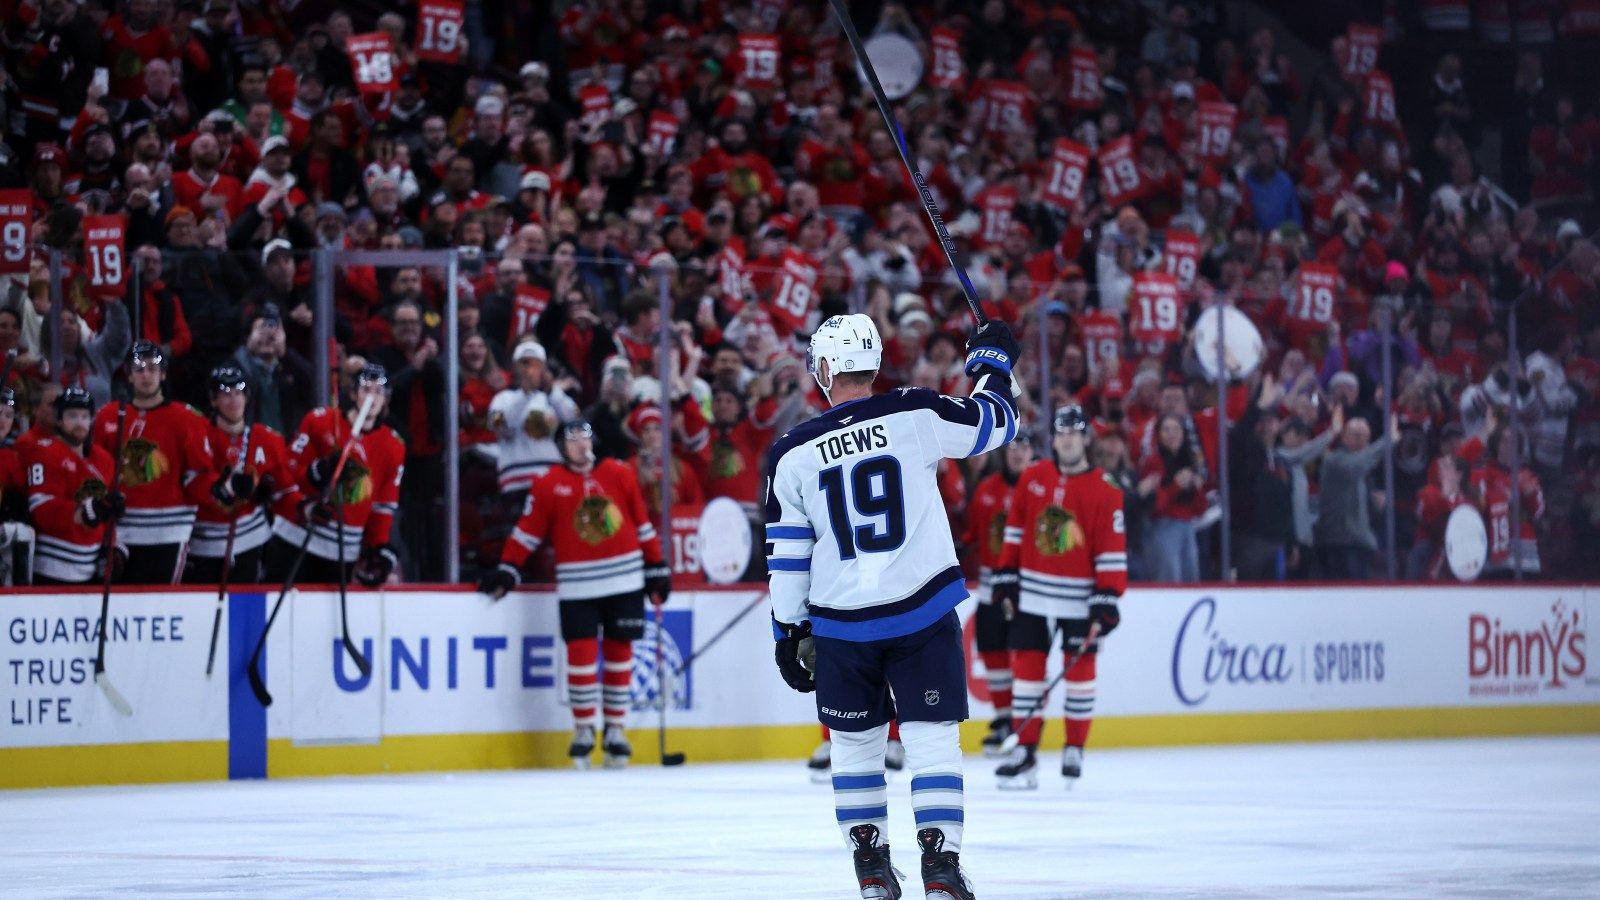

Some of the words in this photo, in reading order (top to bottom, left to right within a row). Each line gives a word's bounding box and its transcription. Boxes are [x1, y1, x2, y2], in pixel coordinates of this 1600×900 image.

[422, 16, 460, 53] 19
[743, 48, 778, 80] 19
[1347, 44, 1377, 73] 19
[1200, 124, 1231, 156] 19
[1048, 162, 1084, 200] 19
[1104, 157, 1140, 197] 19
[90, 243, 122, 286] 19
[776, 273, 812, 317] 19
[1138, 297, 1178, 331] 19
[1299, 294, 1333, 332] 19
[862, 338, 873, 350] 19
[255, 446, 266, 465] A
[815, 424, 888, 465] TOEWS
[819, 455, 906, 561] 19
[671, 533, 703, 574] 19
[9, 616, 184, 644] GUARANTEE
[1469, 609, 1586, 688] Binny's
[333, 634, 606, 693] UNITE
[1172, 596, 1293, 706] Circa
[1314, 641, 1385, 684] SPORTS
[11, 698, 72, 725] LIFE
[821, 706, 869, 719] BAUER
